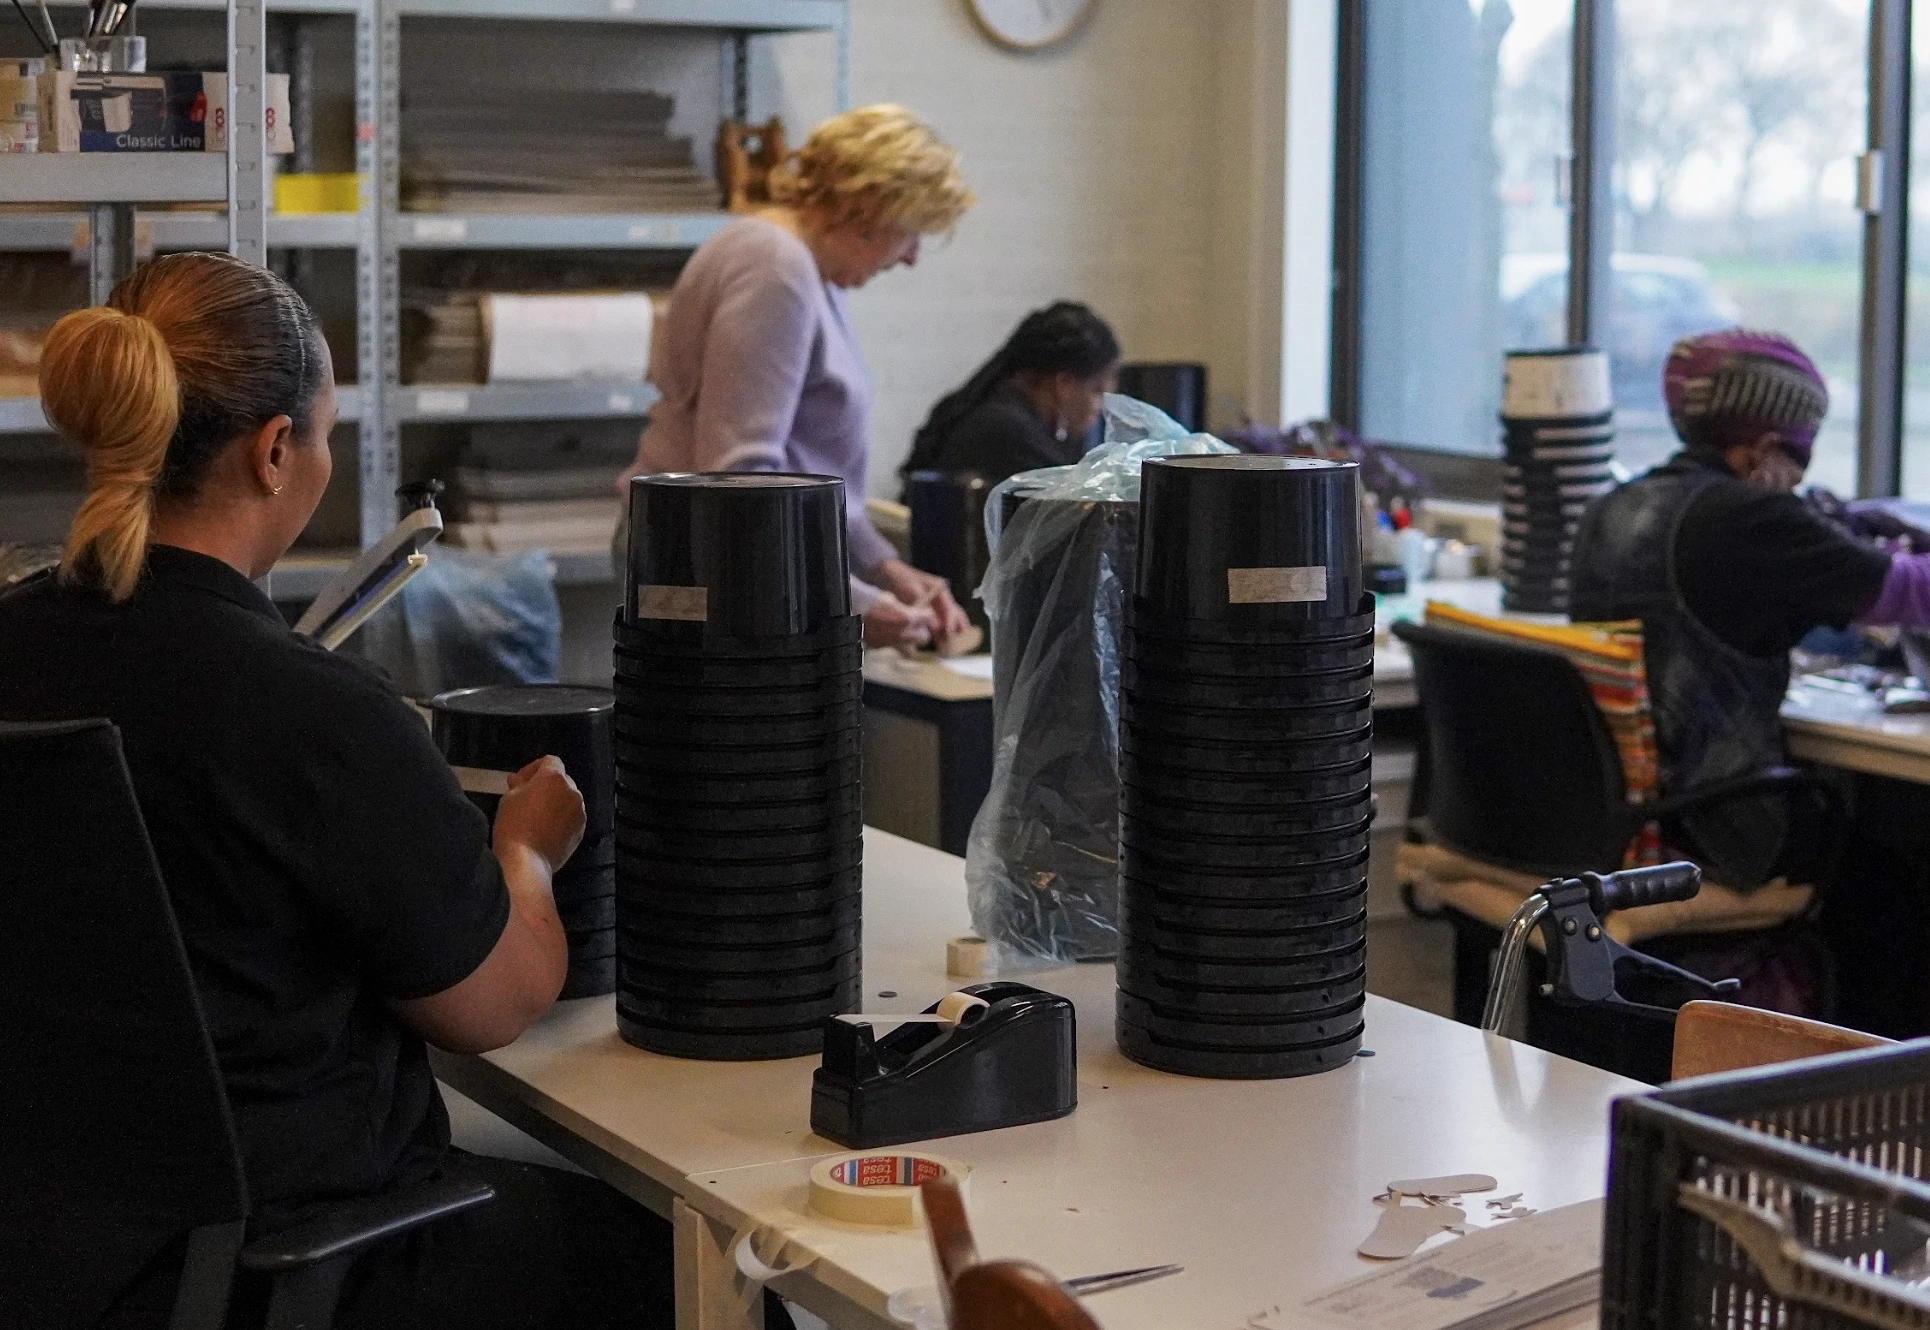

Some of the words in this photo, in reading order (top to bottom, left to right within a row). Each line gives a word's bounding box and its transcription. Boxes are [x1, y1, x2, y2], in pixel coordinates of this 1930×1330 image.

[116, 133, 166, 149] Classic
[171, 133, 202, 149] Line
[863, 1164, 893, 1175] tesa
[862, 1176, 892, 1185] tesa
